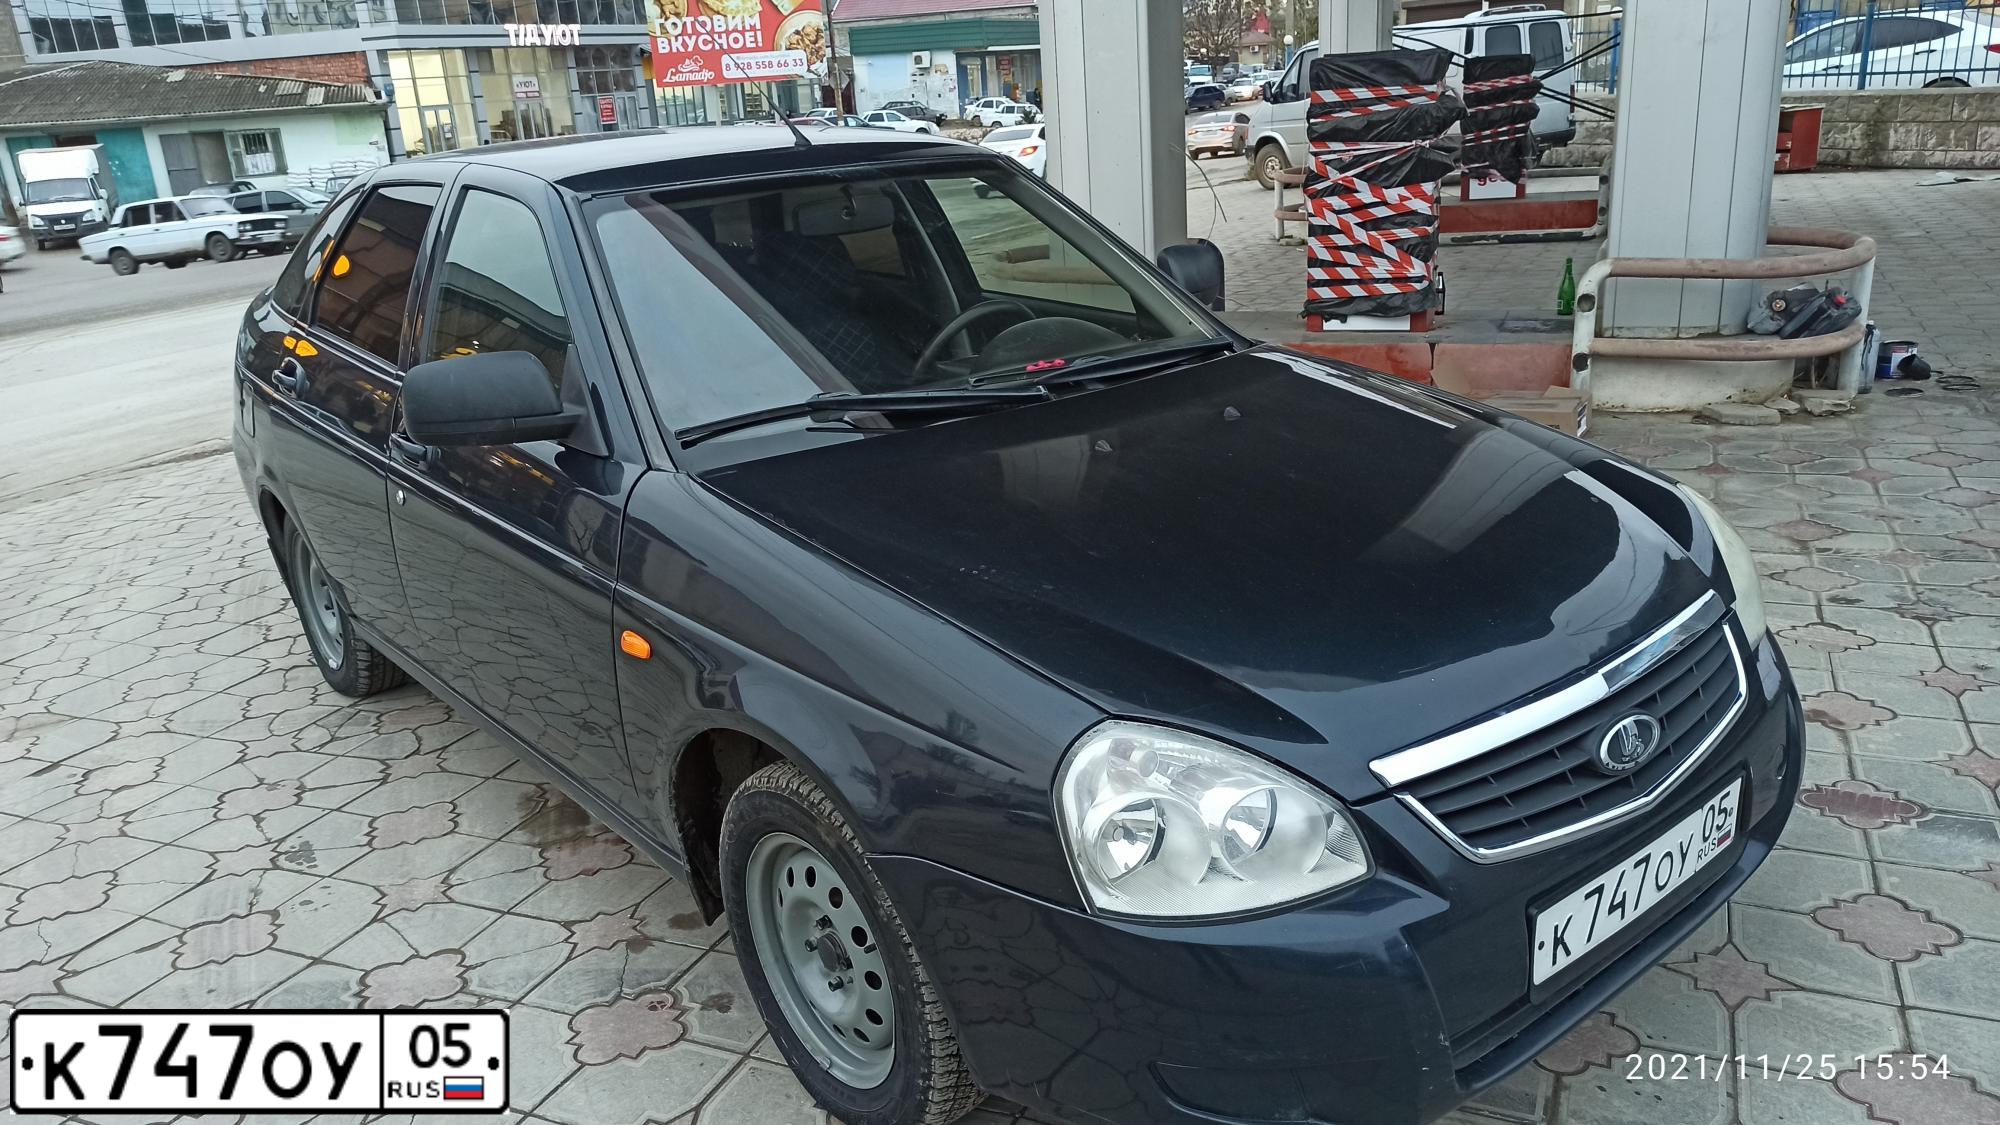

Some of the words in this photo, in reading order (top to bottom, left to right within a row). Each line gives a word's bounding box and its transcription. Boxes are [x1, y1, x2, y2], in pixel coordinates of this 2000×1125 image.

[654, 13, 762, 36] ГОТОВИМ
[656, 30, 763, 54] ВКУСНОЕ!
[662, 67, 715, 83] Lamadjo
[725, 63, 732, 72] 8
[734, 61, 753, 71] 928
[755, 60, 774, 70] 558
[776, 59, 790, 68] 66
[792, 58, 804, 67] 33
[1702, 790, 1731, 843] 05
[1696, 837, 1718, 864] RUS
[1551, 832, 1694, 966] К747ОУ
